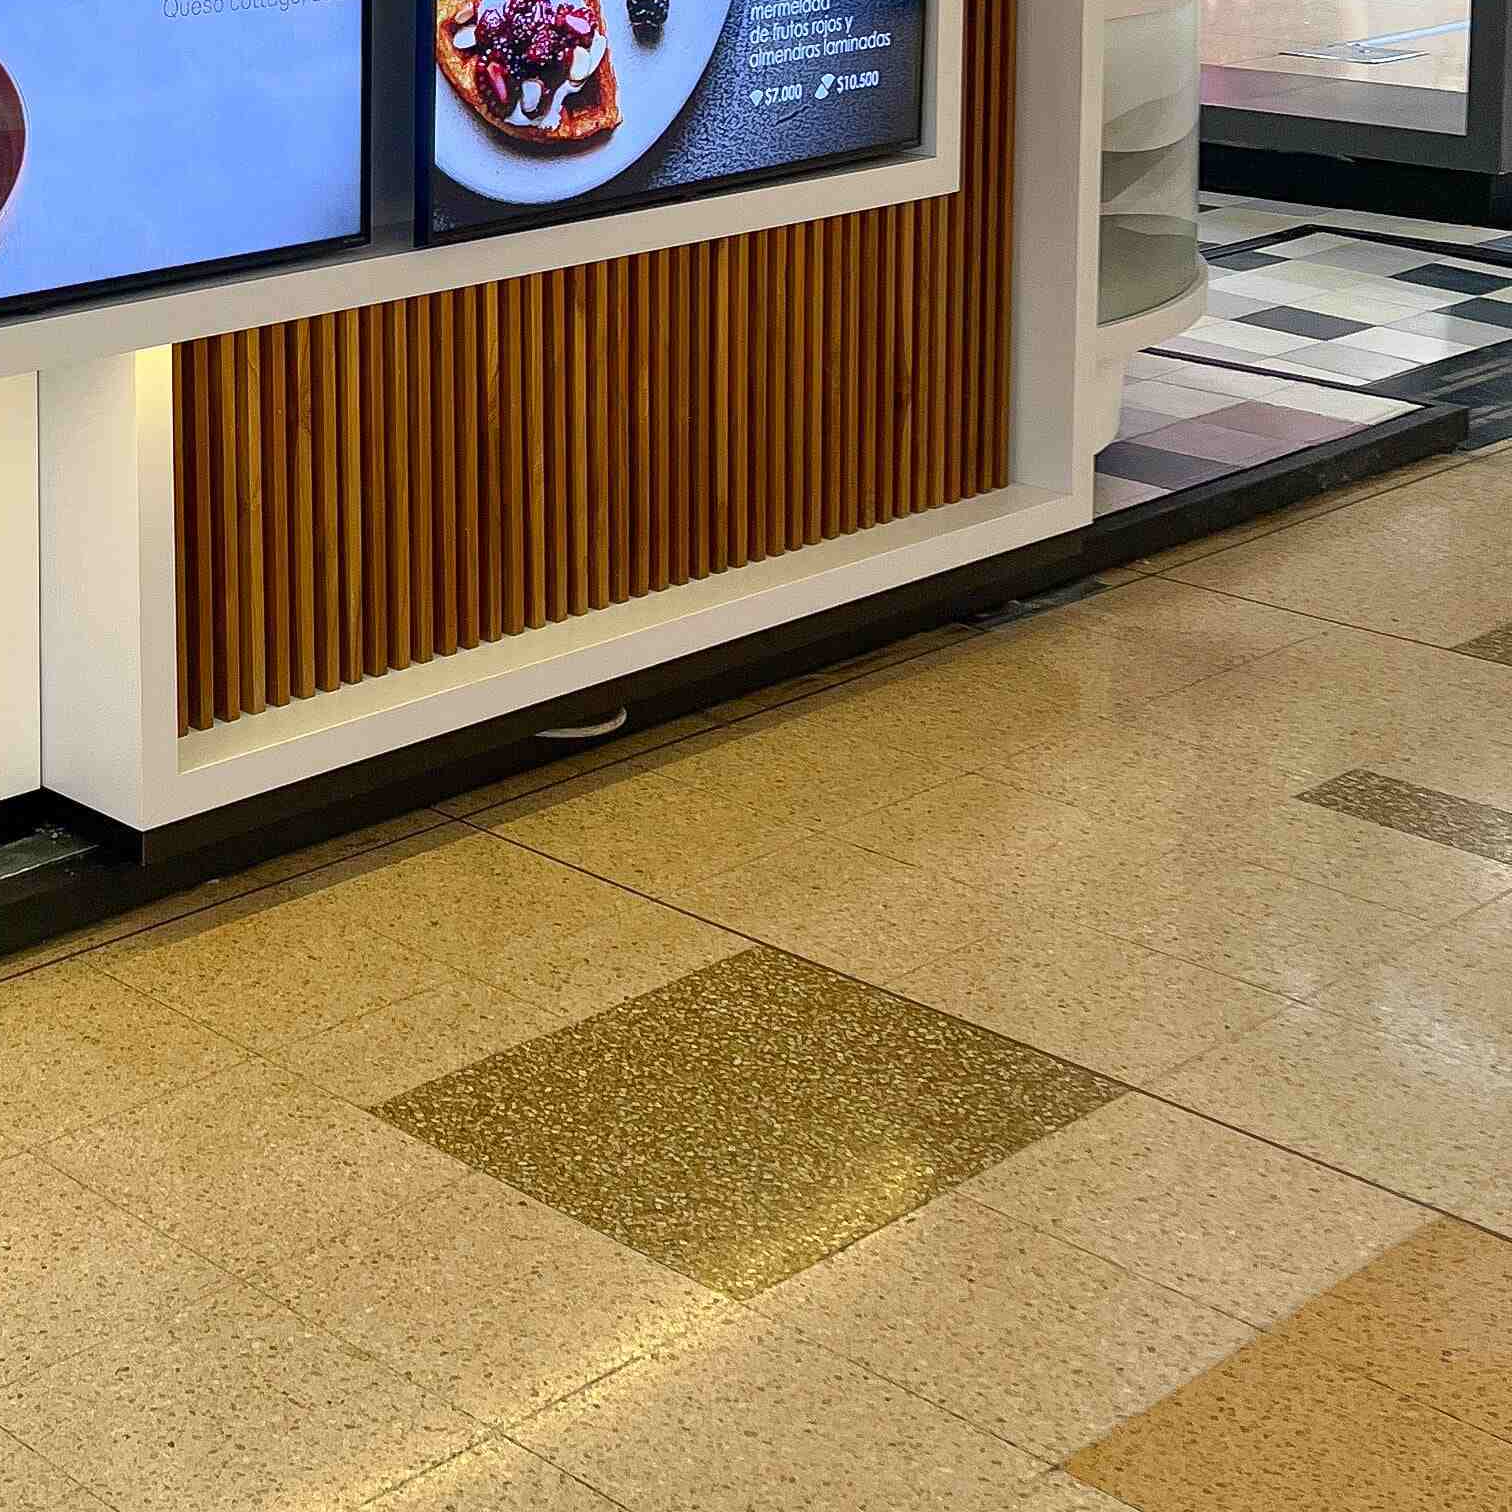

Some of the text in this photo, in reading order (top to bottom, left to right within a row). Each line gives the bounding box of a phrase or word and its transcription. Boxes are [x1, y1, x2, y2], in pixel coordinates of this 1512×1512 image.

[750, 15, 854, 44] de frutos rojos y
[749, 31, 891, 68] almendras laminadas
[764, 83, 803, 106] $7.000
[837, 70, 880, 94] $10.500
